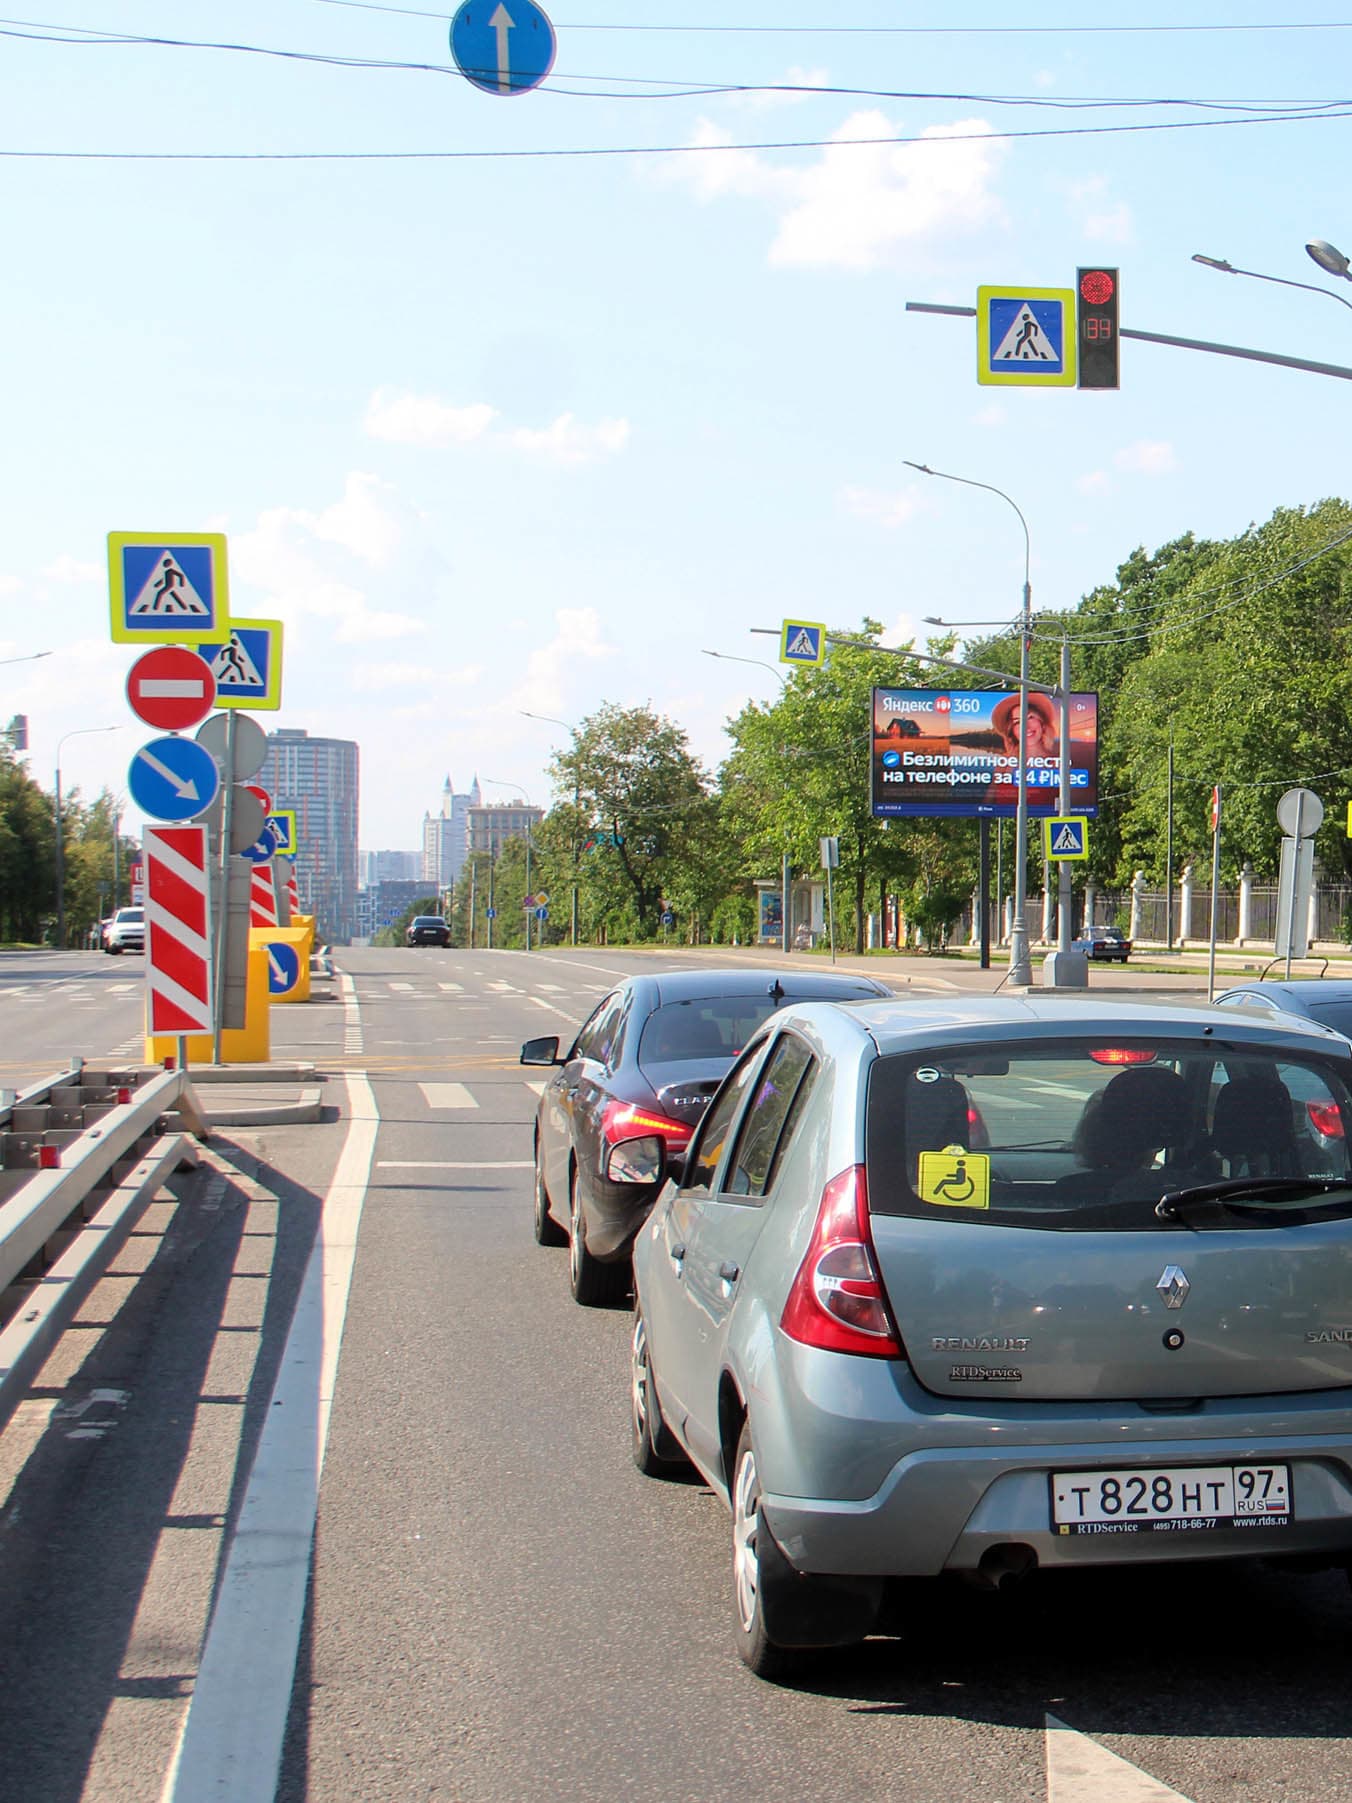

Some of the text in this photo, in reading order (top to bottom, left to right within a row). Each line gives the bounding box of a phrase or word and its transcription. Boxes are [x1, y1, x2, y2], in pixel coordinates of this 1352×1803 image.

[883, 697, 980, 713] Яндекс 360
[903, 751, 1018, 768] Безлимитное
[883, 772, 904, 784] на
[908, 772, 992, 787] телефоне
[994, 774, 1013, 785] за
[931, 1338, 1031, 1352] RENAULT
[952, 1366, 1020, 1377] RTDService
[1071, 1469, 1274, 1517] Т828НТ 97
[1237, 1500, 1265, 1512] RUS
[1077, 1522, 1139, 1535] RTDService
[1233, 1516, 1288, 1528] www.rtds.ru
